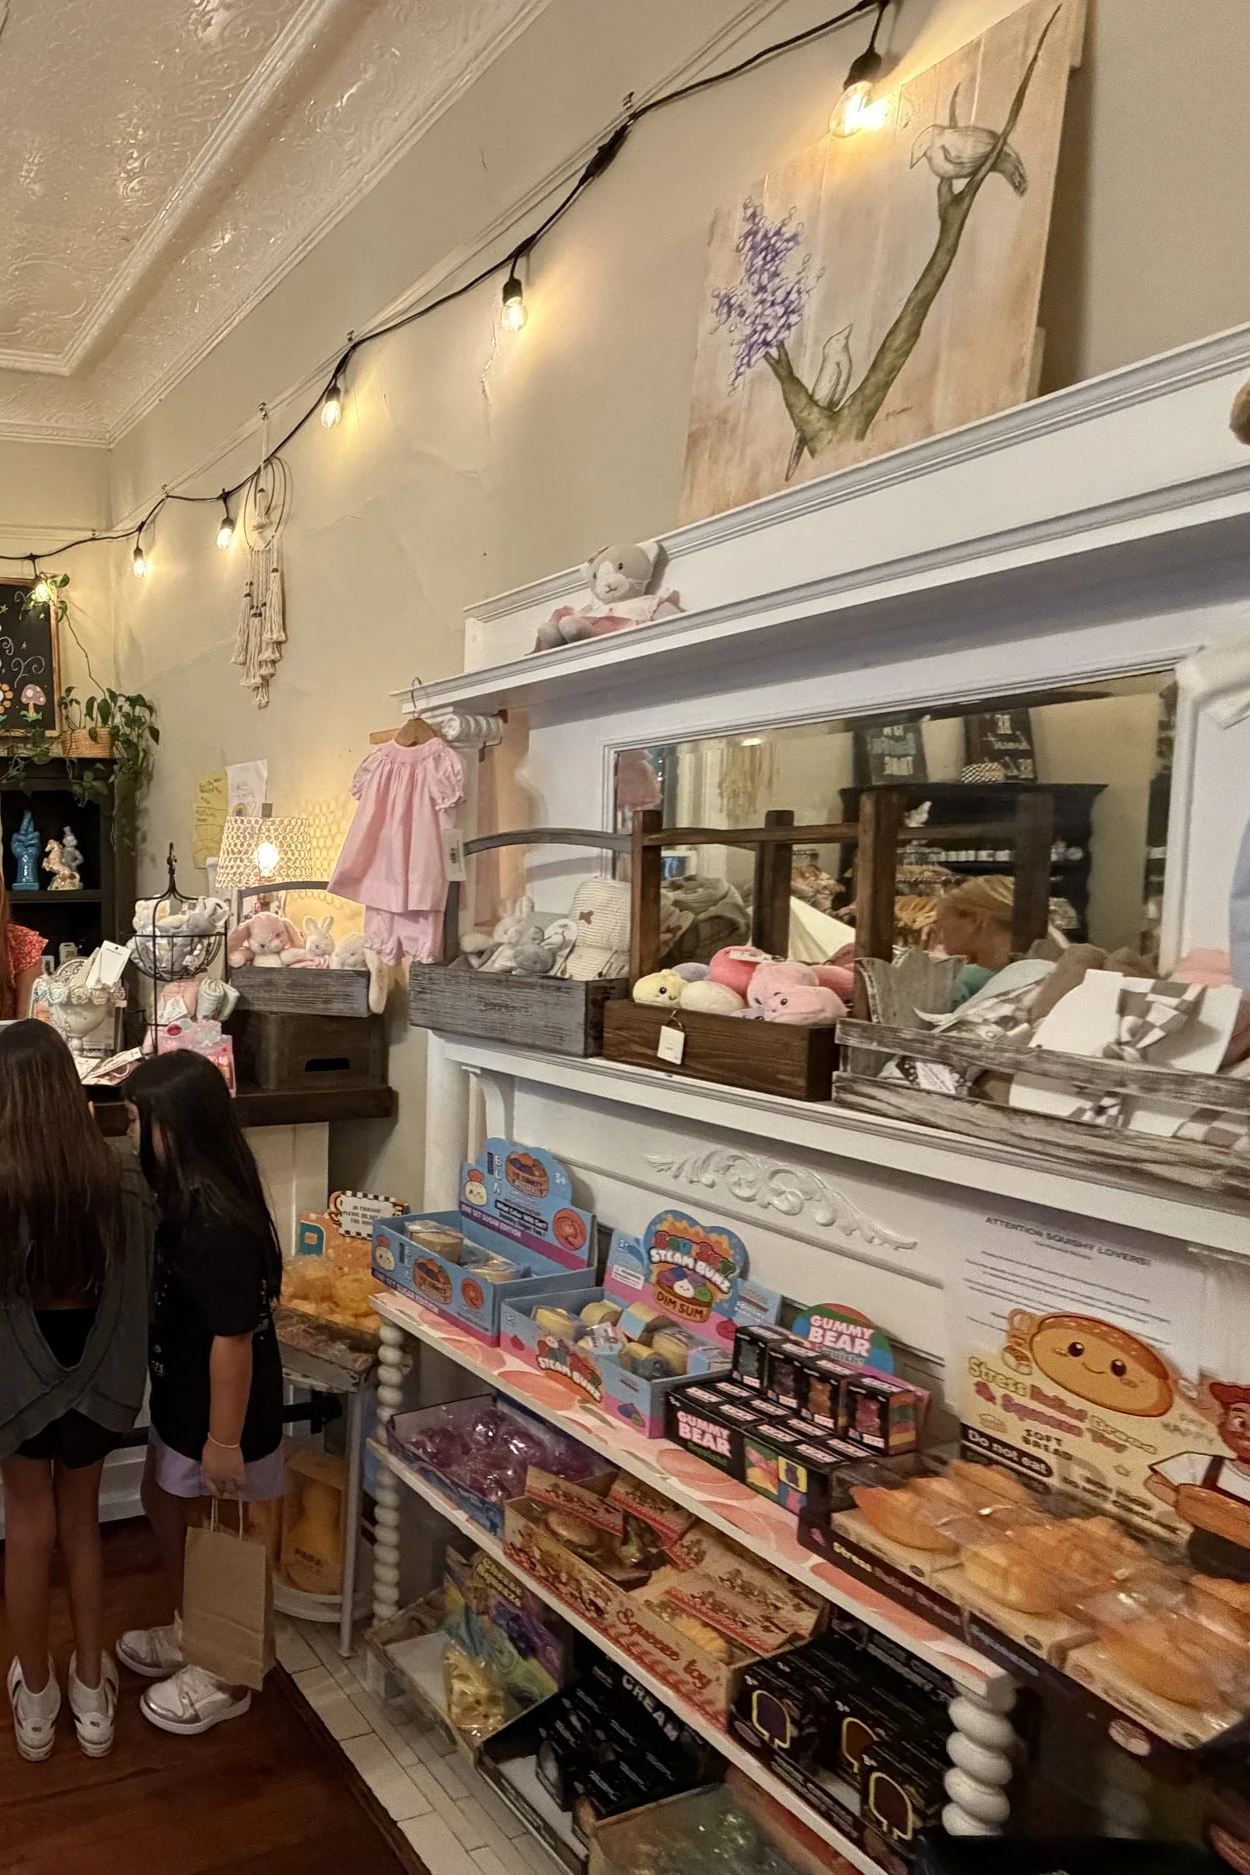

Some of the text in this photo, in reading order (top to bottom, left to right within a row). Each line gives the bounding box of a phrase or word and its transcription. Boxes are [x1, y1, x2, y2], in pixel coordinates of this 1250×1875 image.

[985, 1216, 1044, 1238] ATTENTION
[650, 1247, 731, 1294] STEAM BUNZ
[657, 1292, 704, 1318] DIM SUM
[808, 1326, 871, 1357] BEAR
[810, 1315, 875, 1339] GUMMY
[677, 1411, 731, 1441] GUMMY
[678, 1422, 733, 1458] BEAR
[967, 1428, 1049, 1475] Do not eat
